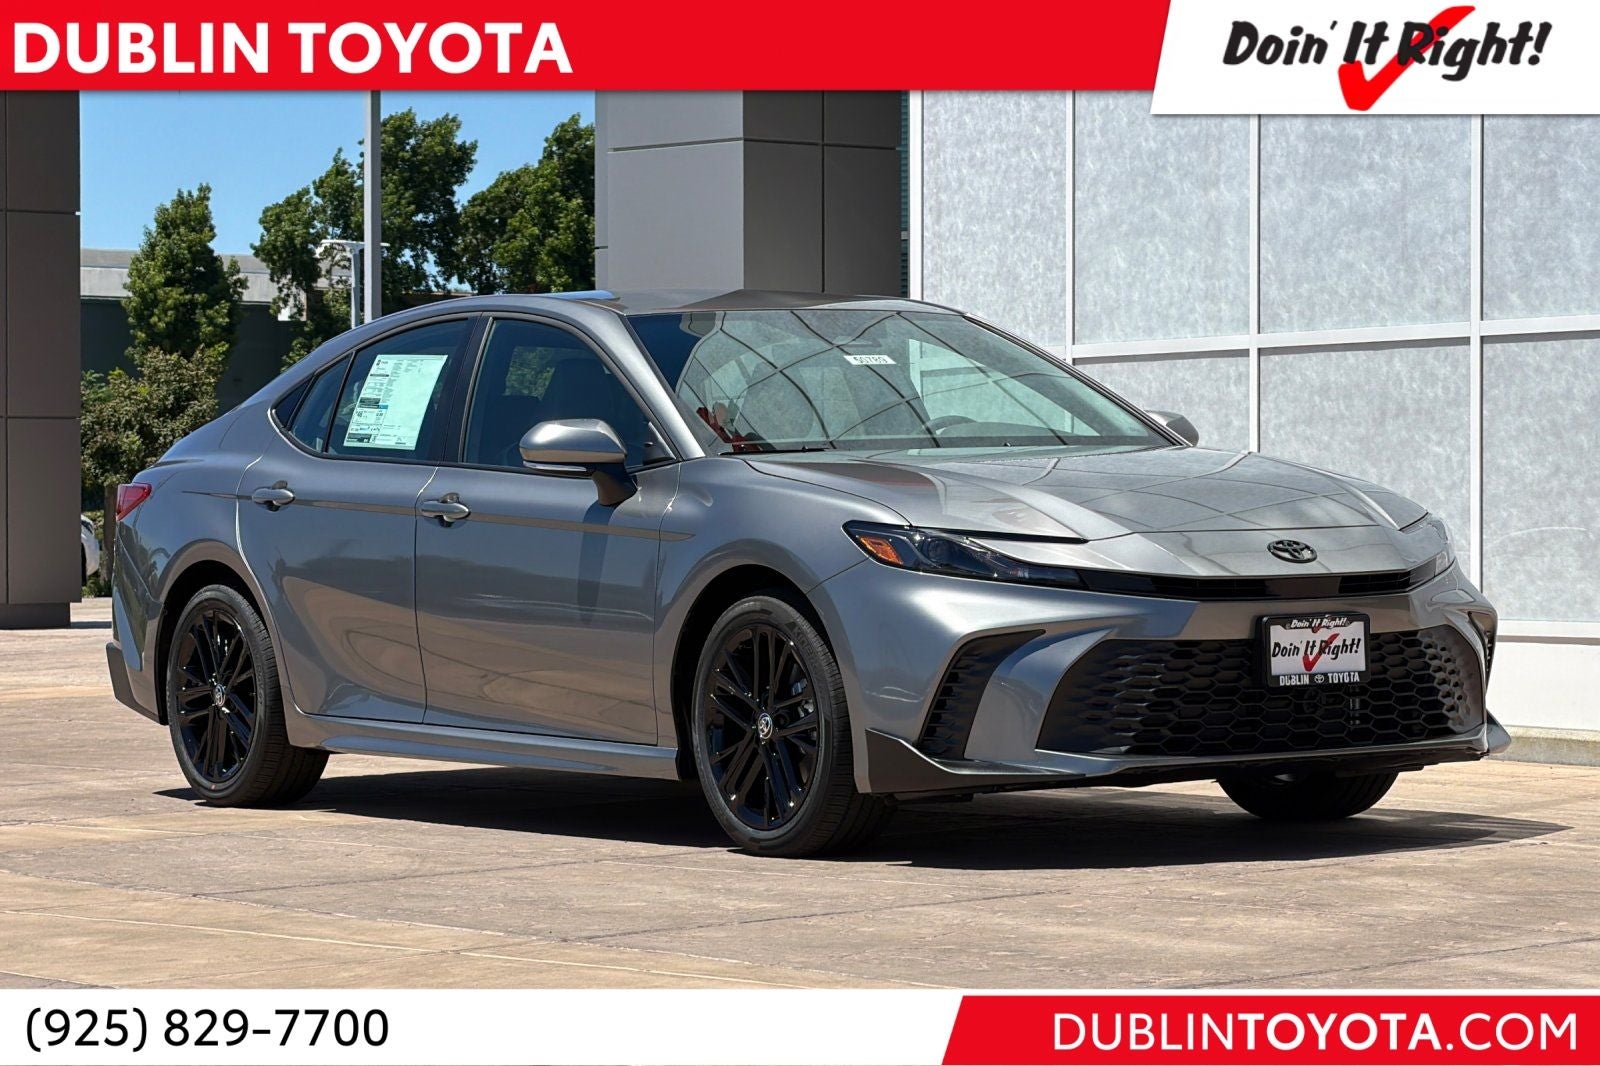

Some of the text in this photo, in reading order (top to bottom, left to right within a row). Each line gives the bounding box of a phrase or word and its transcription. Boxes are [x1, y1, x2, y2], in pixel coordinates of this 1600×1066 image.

[1272, 638, 1361, 660] Doin' It Right!
[1279, 672, 1360, 686] DUBLIN TOYOTA
